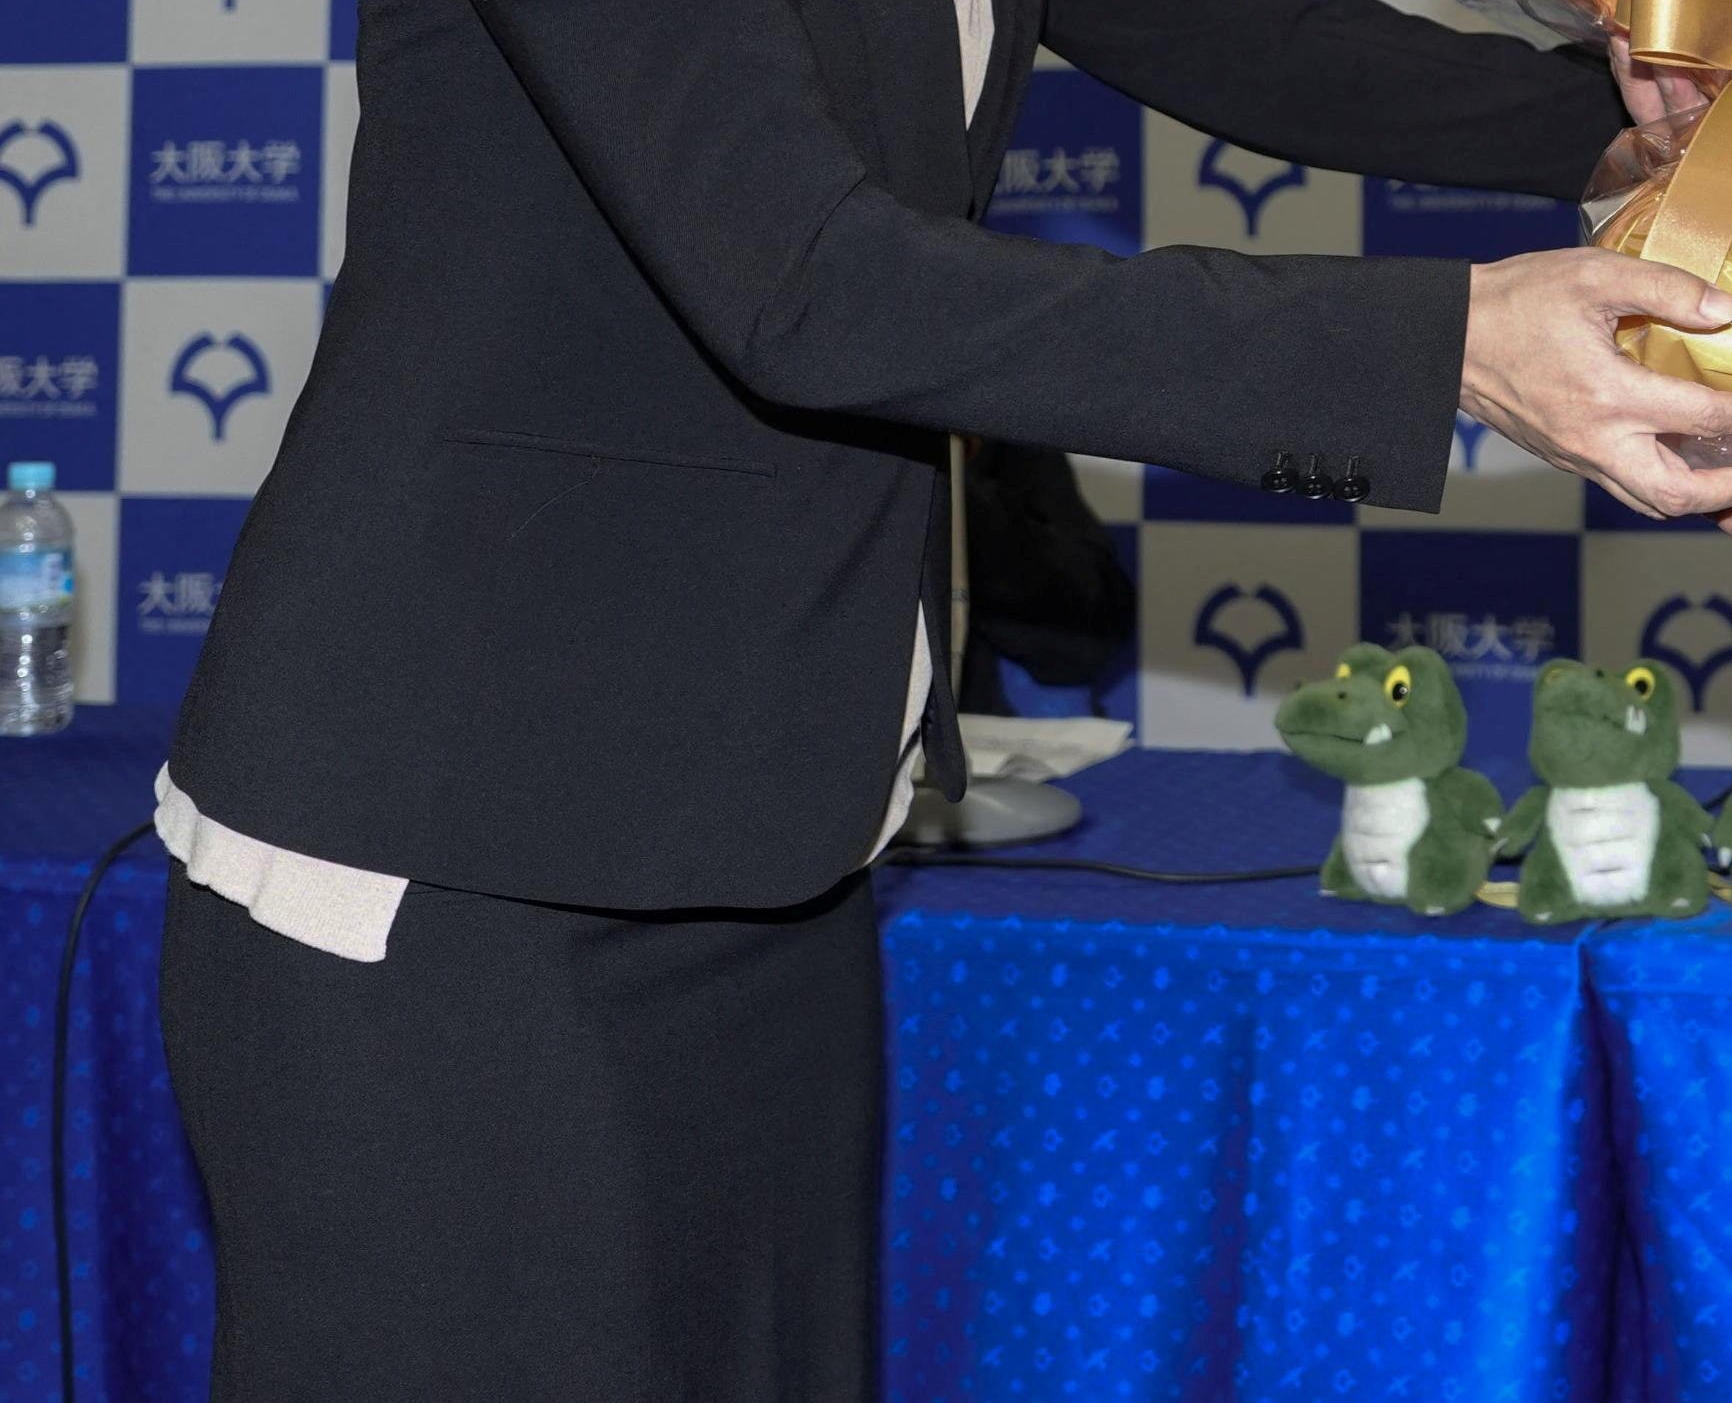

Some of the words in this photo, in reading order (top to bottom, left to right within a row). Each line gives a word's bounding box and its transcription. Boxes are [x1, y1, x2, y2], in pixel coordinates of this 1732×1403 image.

[150, 139, 301, 184] 大阪大学
[996, 147, 1119, 194] 阪大学
[0, 355, 99, 401] 阪大学
[137, 570, 217, 615] 大阪
[1385, 611, 1554, 661] 大阪大学
